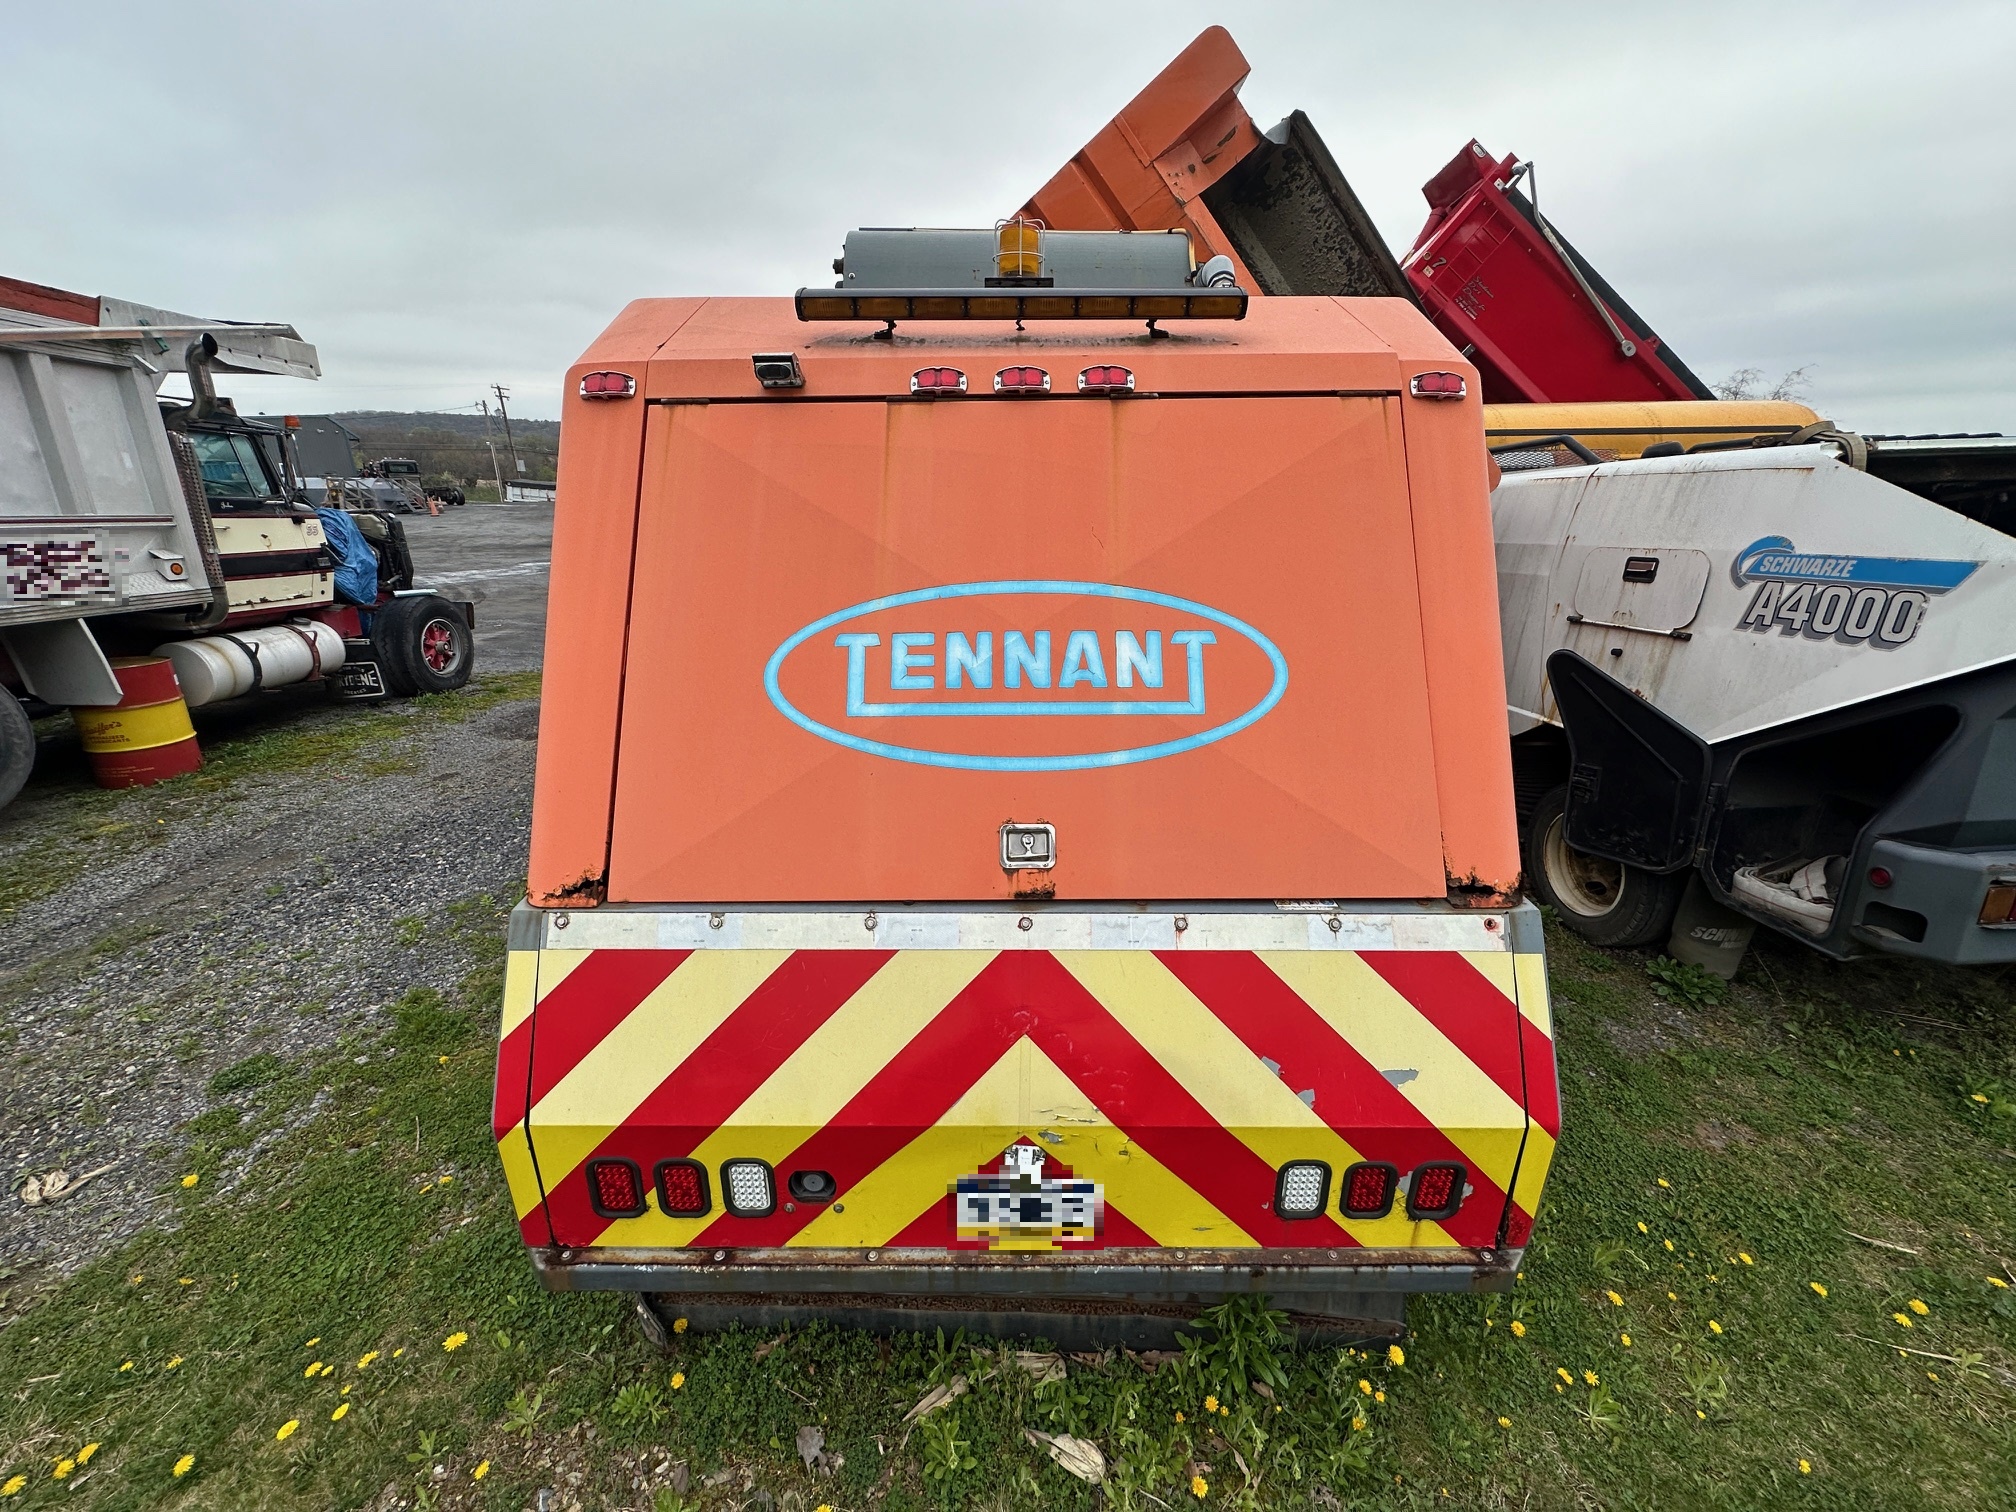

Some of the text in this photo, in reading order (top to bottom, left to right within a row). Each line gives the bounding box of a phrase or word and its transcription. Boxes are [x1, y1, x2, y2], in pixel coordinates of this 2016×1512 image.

[1760, 556, 1857, 578] SCHWARZE
[1738, 580, 1928, 647] A4000
[835, 629, 1217, 715] TENNANT
